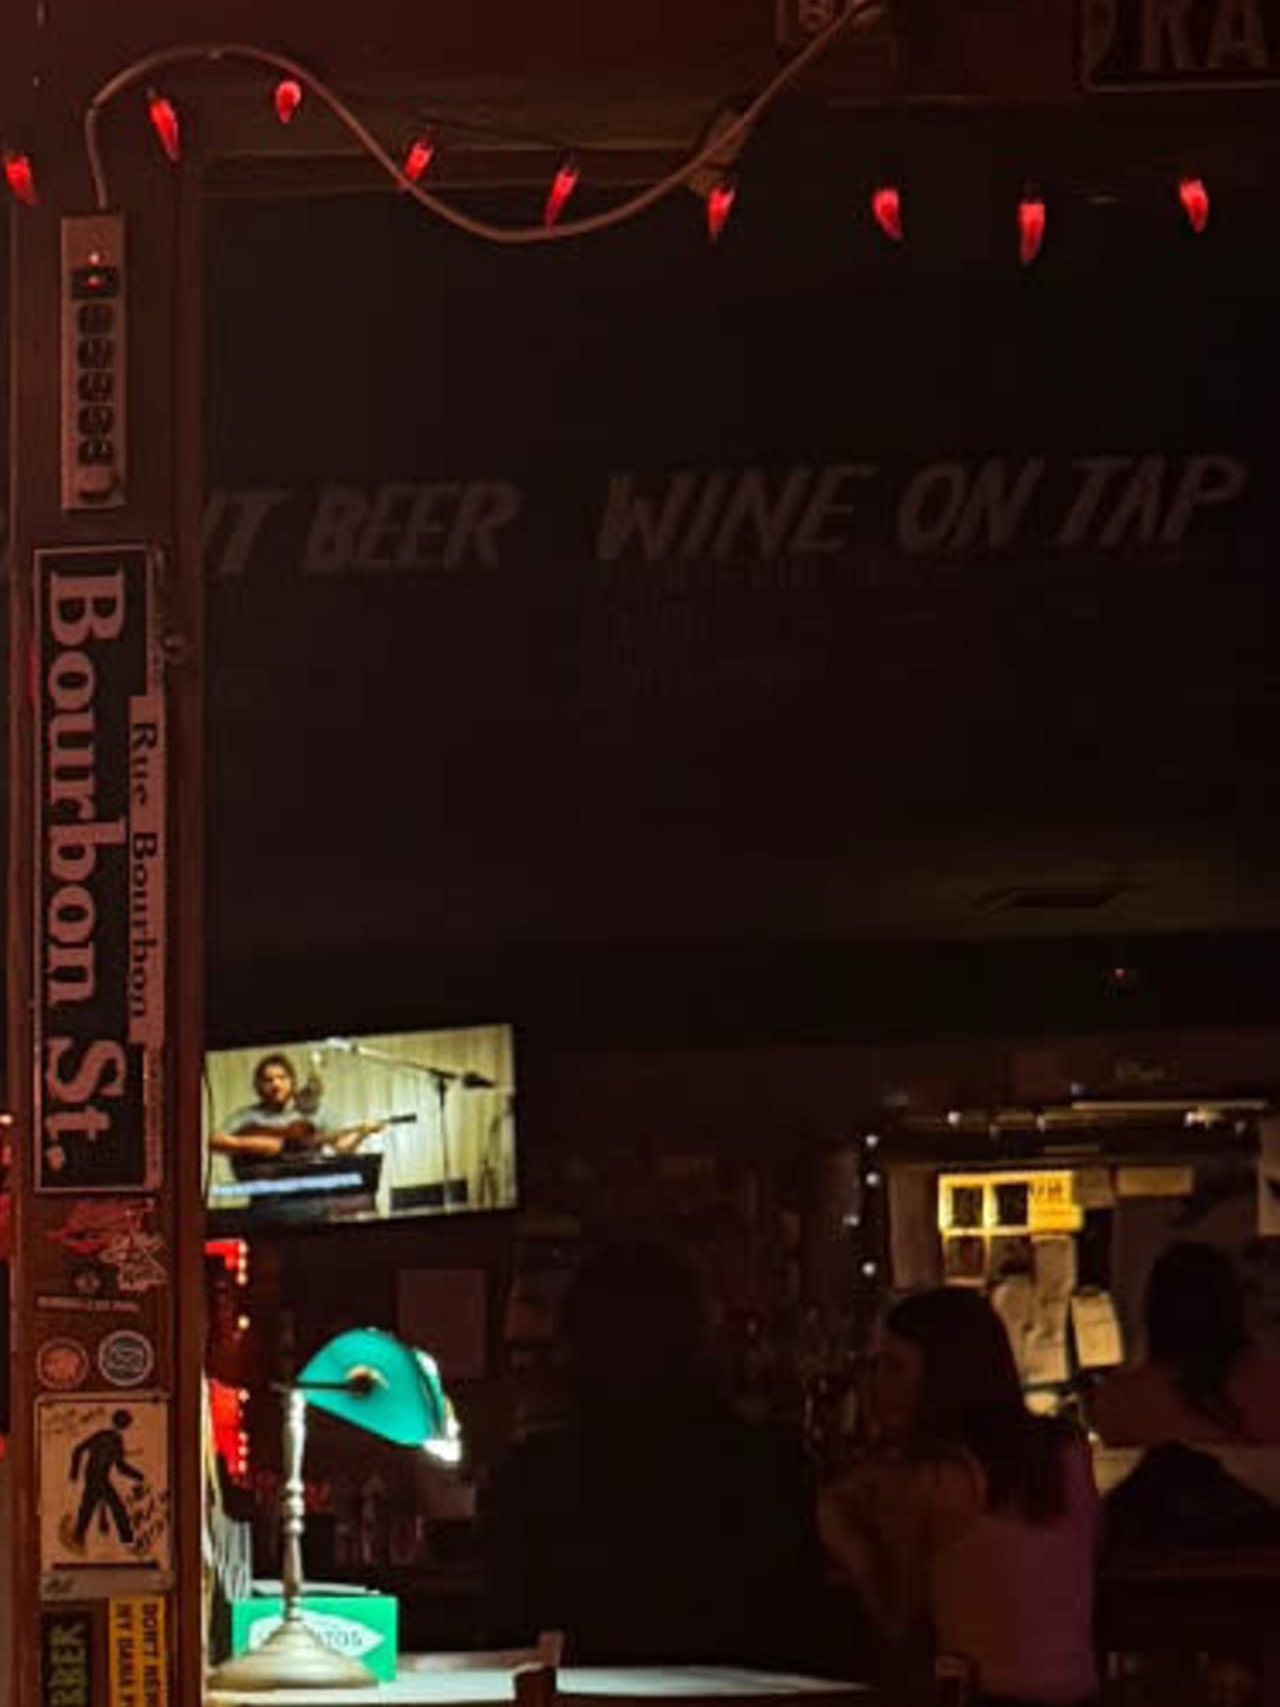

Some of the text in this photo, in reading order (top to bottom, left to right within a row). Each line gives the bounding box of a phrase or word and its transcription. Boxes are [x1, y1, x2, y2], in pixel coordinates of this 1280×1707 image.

[301, 479, 523, 574] BEER
[599, 456, 1245, 560] WINE ON TAP
[131, 721, 158, 806] Rue
[45, 563, 127, 1172] Bourbon St.
[131, 832, 158, 1018] Bourbon
